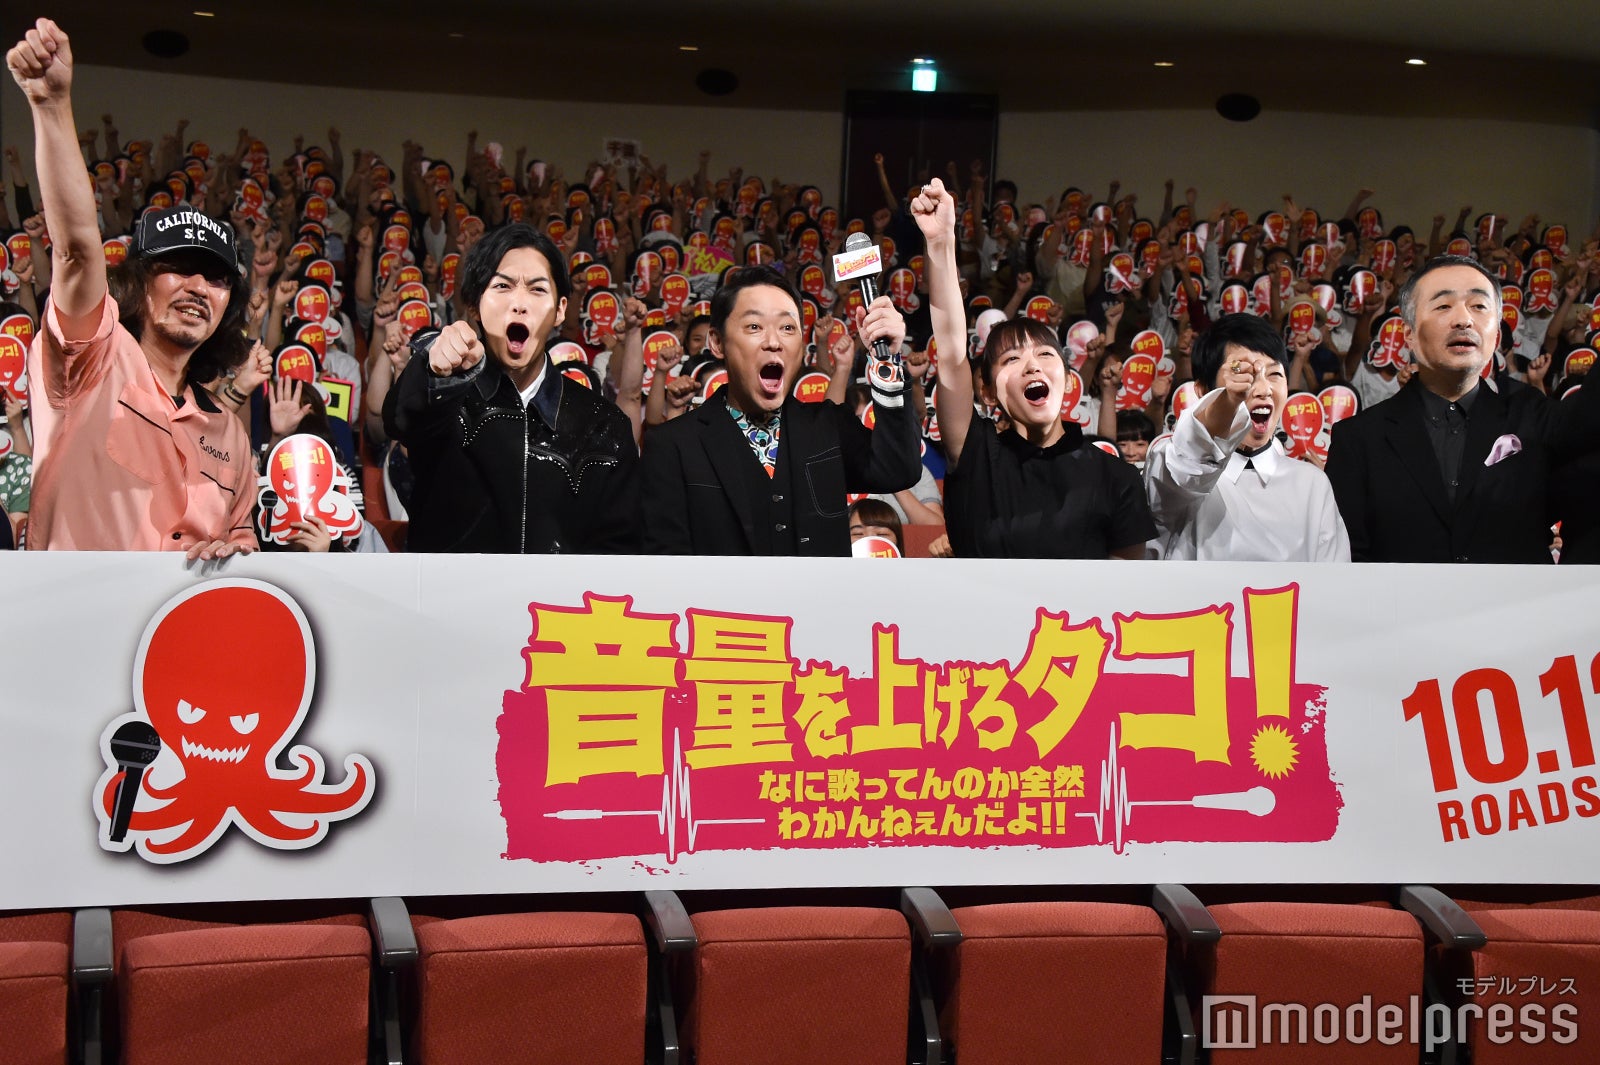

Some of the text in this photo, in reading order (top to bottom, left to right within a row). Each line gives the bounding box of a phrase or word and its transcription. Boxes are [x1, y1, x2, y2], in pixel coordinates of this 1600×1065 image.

[156, 211, 228, 245] CALIFORNIA
[278, 446, 326, 470] 音コ!
[524, 582, 1301, 788] 音量を上げろタコ!
[757, 764, 1086, 804] なに歌ってんのか全然
[777, 801, 1067, 841] わかんねぇんだよ!!
